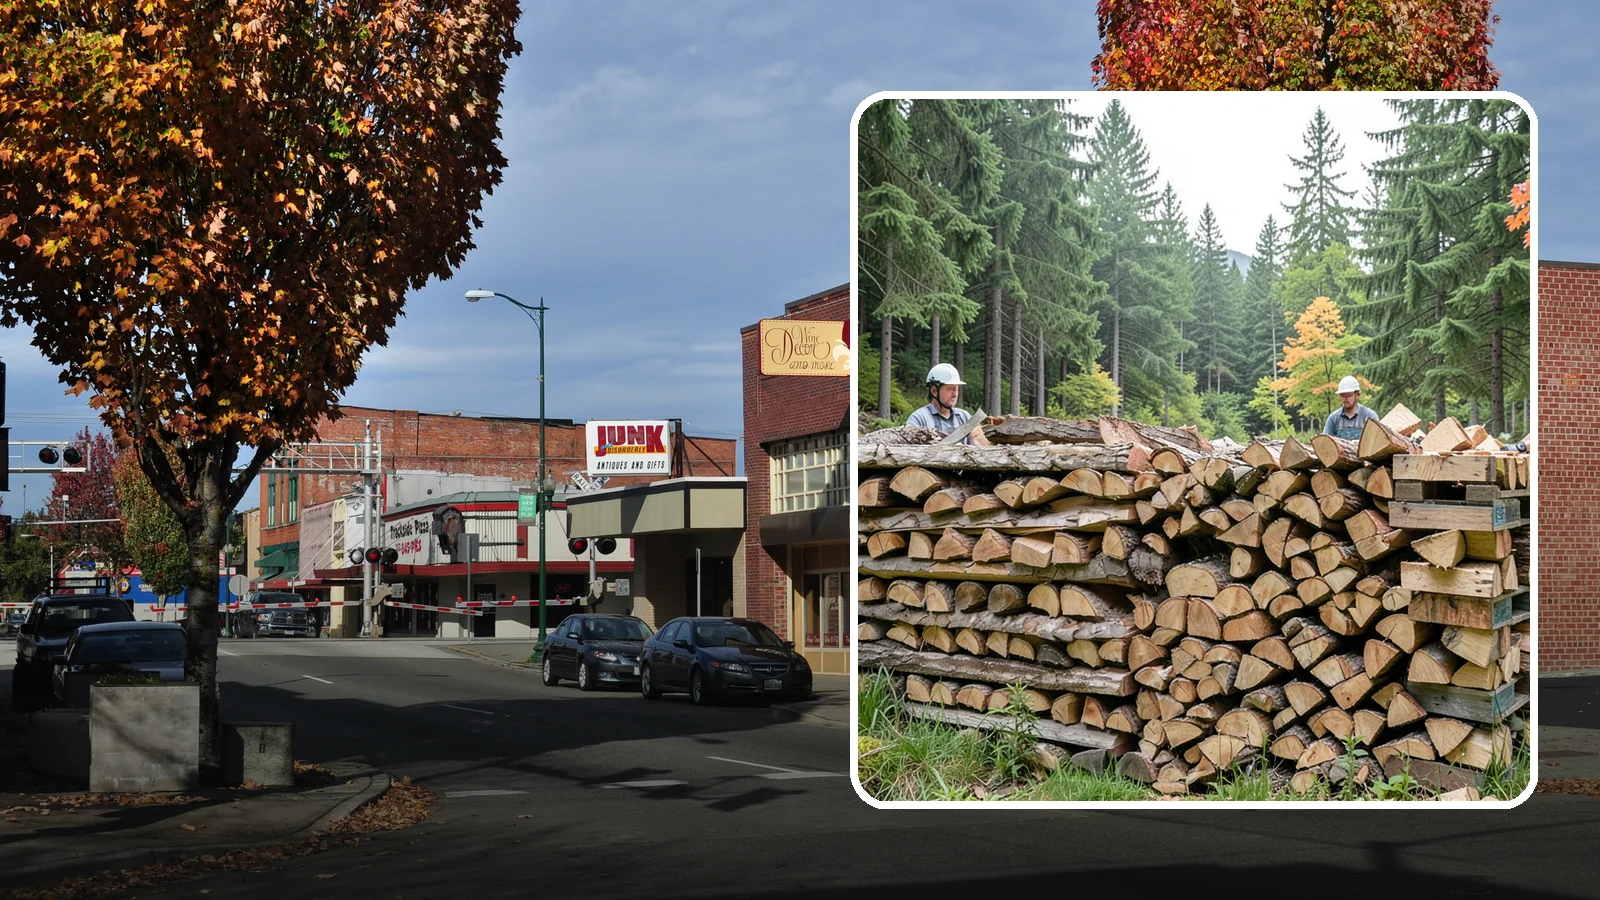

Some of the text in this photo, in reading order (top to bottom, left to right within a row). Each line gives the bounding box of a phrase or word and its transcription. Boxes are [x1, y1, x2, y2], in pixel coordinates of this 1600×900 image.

[765, 328, 831, 365] Decor
[596, 425, 665, 457] JUNK
[607, 446, 646, 454] DISORDERLY
[597, 460, 665, 470] ANTIQUES AND GIFTS
[390, 520, 429, 539] Trackside Pizza
